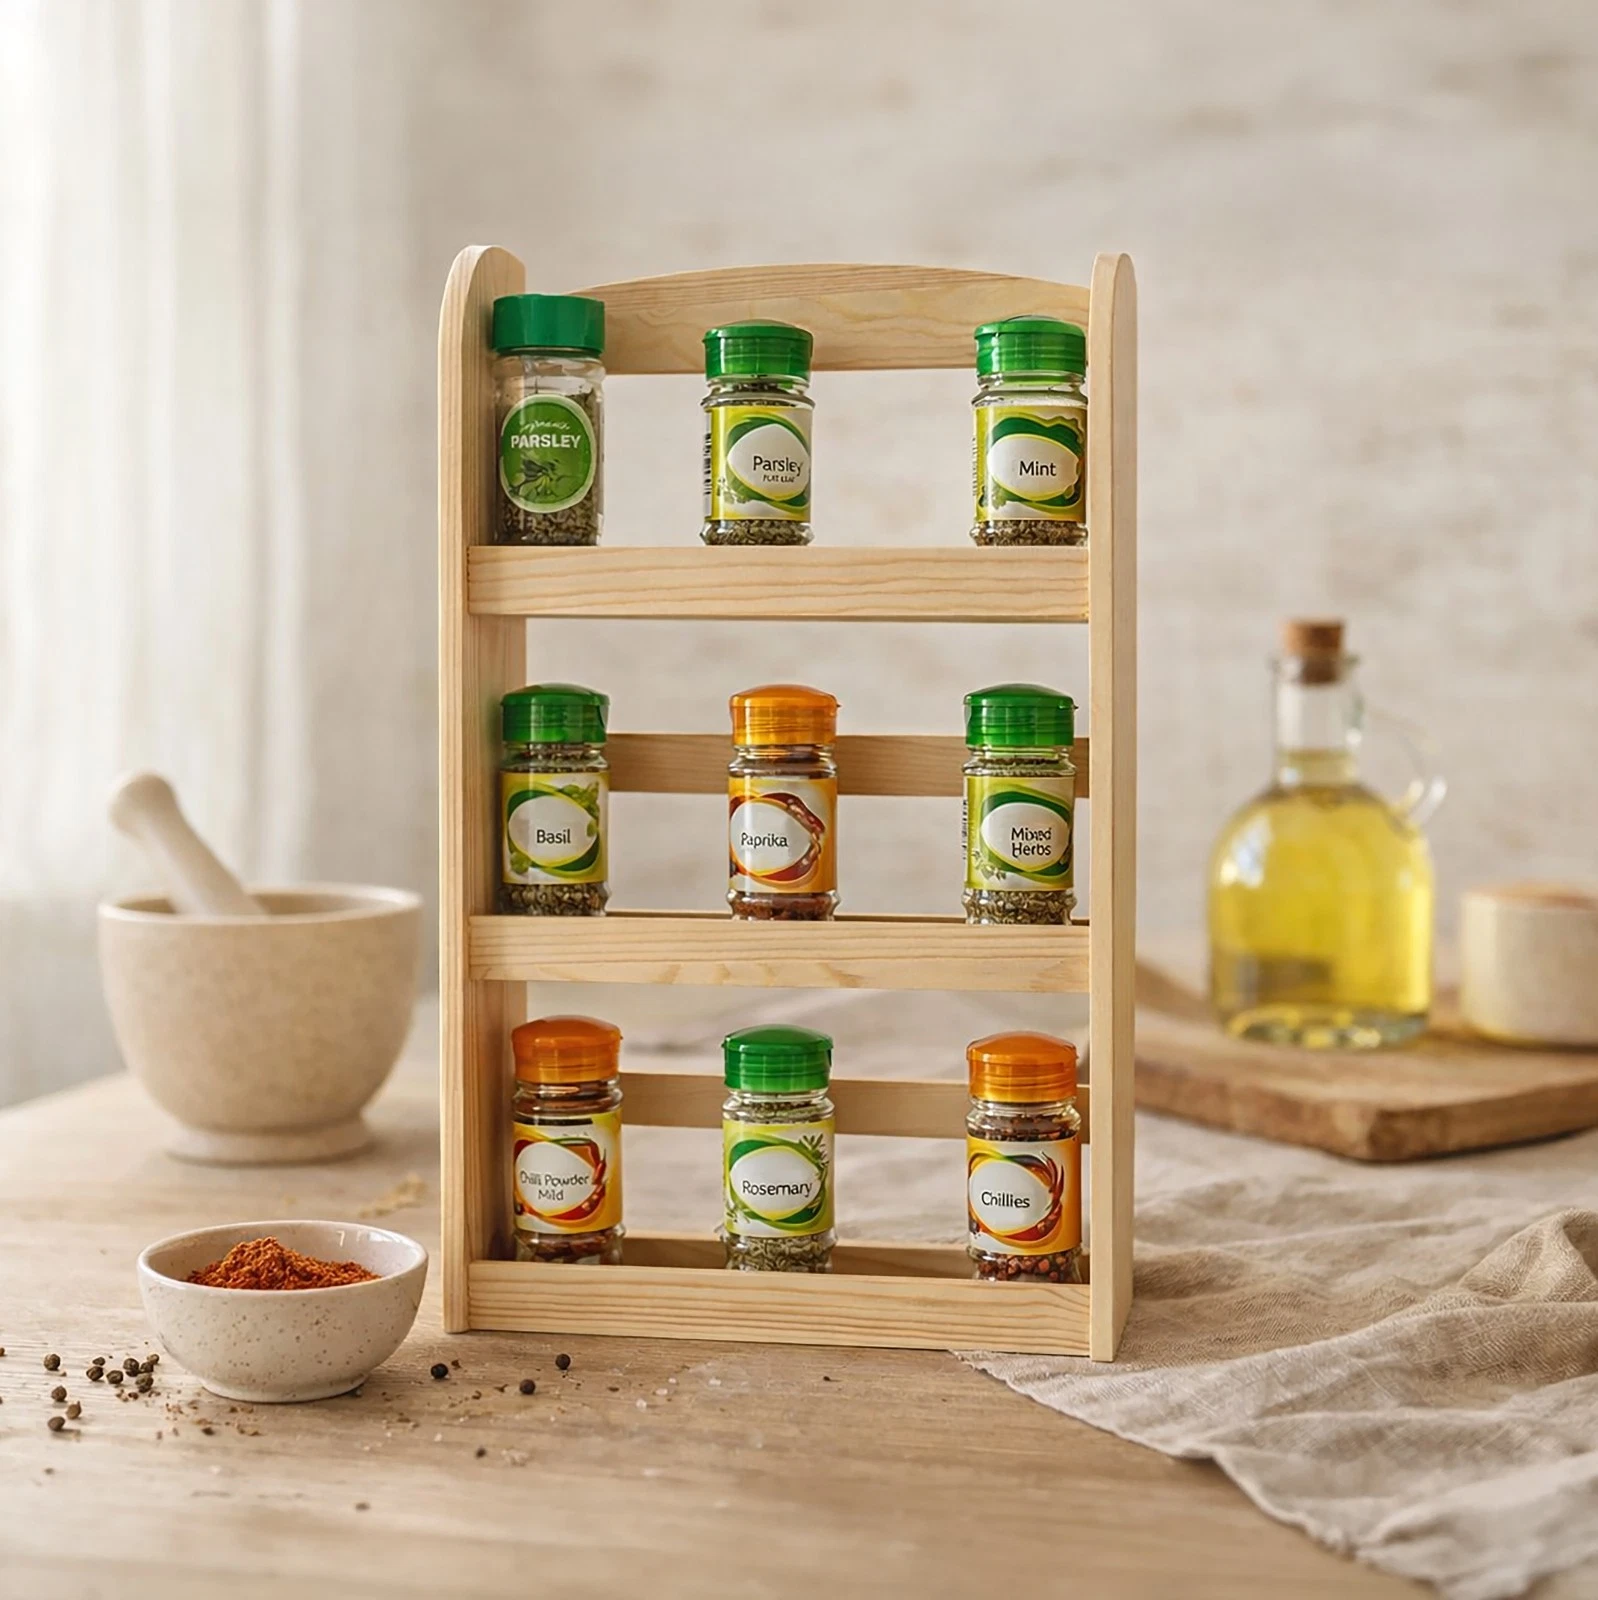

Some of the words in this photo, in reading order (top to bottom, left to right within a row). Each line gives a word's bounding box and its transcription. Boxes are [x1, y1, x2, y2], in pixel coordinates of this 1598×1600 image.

[511, 434, 581, 449] PARSLEY
[753, 455, 803, 477] Parsley
[1019, 460, 1057, 476] Mint
[536, 829, 571, 844] Basil
[741, 832, 789, 849] Paprika
[1011, 842, 1052, 858] Herbs
[544, 1174, 589, 1187] Powder
[538, 1189, 564, 1201] Mild
[742, 1180, 813, 1198] Rosemary
[981, 1191, 1030, 1209] Chillies
